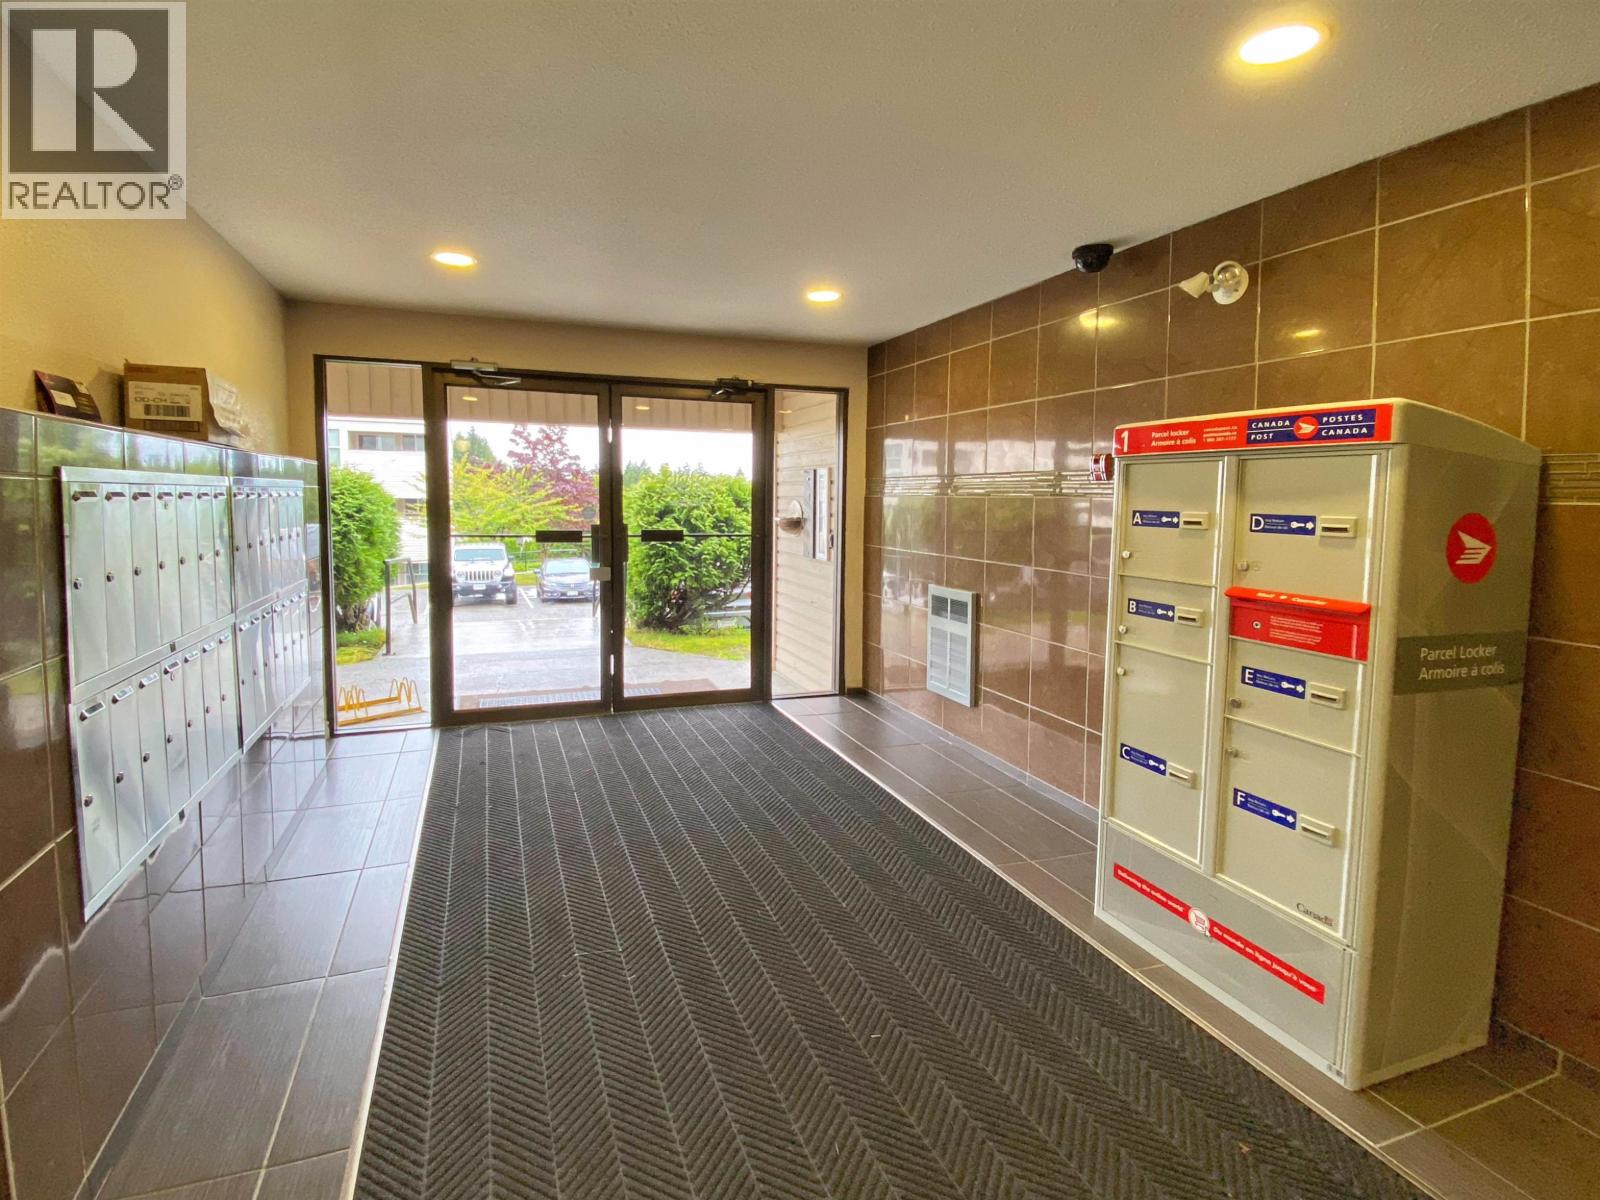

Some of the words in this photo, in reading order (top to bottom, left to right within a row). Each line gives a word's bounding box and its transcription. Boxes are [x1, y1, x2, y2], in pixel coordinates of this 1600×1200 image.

[1251, 420, 1291, 429] CANADA
[1322, 413, 1364, 424] POSTES
[1151, 430, 1169, 439] Parcel
[1170, 429, 1190, 437] locker
[1250, 433, 1273, 441] POST
[1321, 427, 1368, 436] CANADA
[1121, 430, 1129, 453] 1
[1151, 439, 1175, 447] Armoire
[1181, 437, 1197, 445] colis
[1132, 512, 1142, 525] A
[1251, 515, 1265, 531] D
[1129, 600, 1137, 613] B
[1420, 645, 1457, 661] Parcel
[1459, 643, 1497, 659] Locker
[1245, 668, 1254, 684] E
[1418, 664, 1468, 680] Armoire
[1471, 663, 1478, 676] à
[1480, 661, 1505, 675] colis
[1122, 746, 1131, 760] C
[1236, 791, 1246, 805] F
